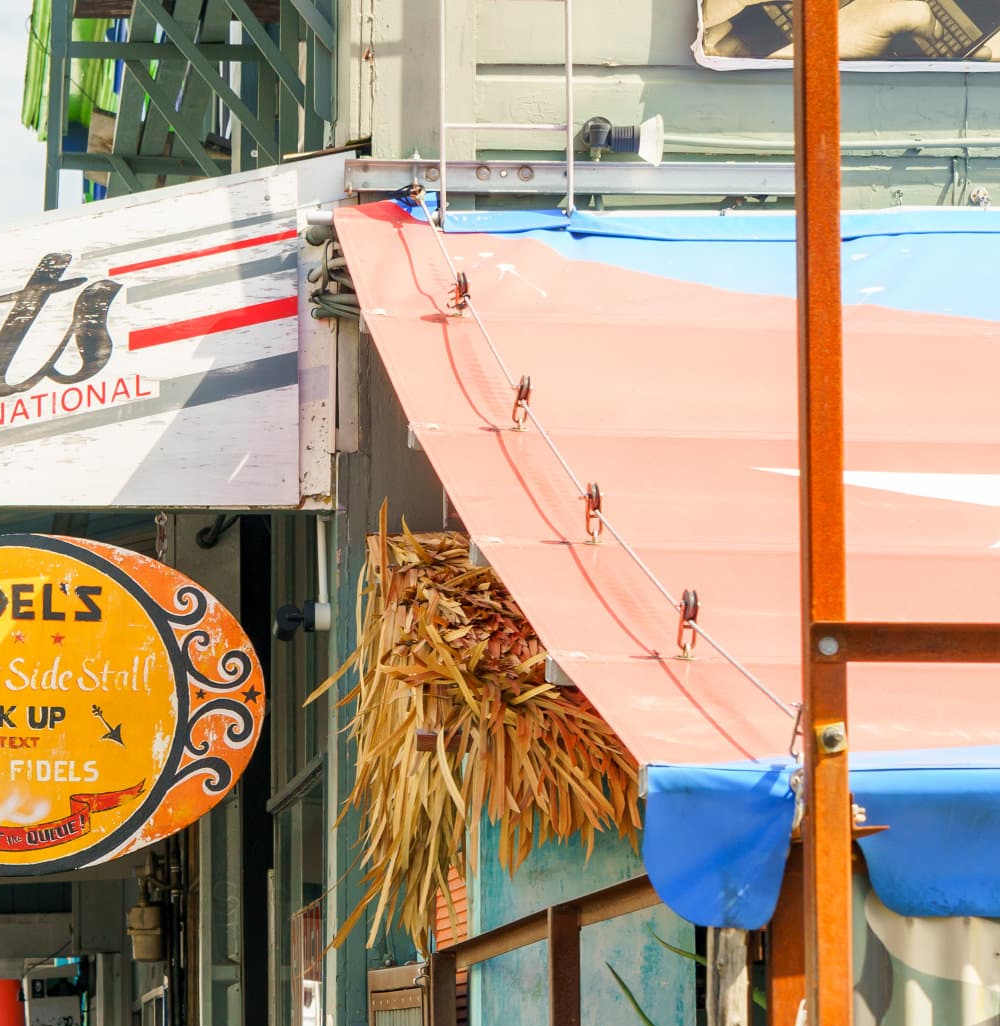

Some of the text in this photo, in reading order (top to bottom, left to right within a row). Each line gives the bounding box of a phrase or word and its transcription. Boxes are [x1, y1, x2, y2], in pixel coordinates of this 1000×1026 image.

[4, 656, 73, 692] Side
[76, 654, 156, 695] Stall
[27, 706, 67, 730] UP
[9, 759, 100, 783] FIDELS
[6, 833, 23, 845] the
